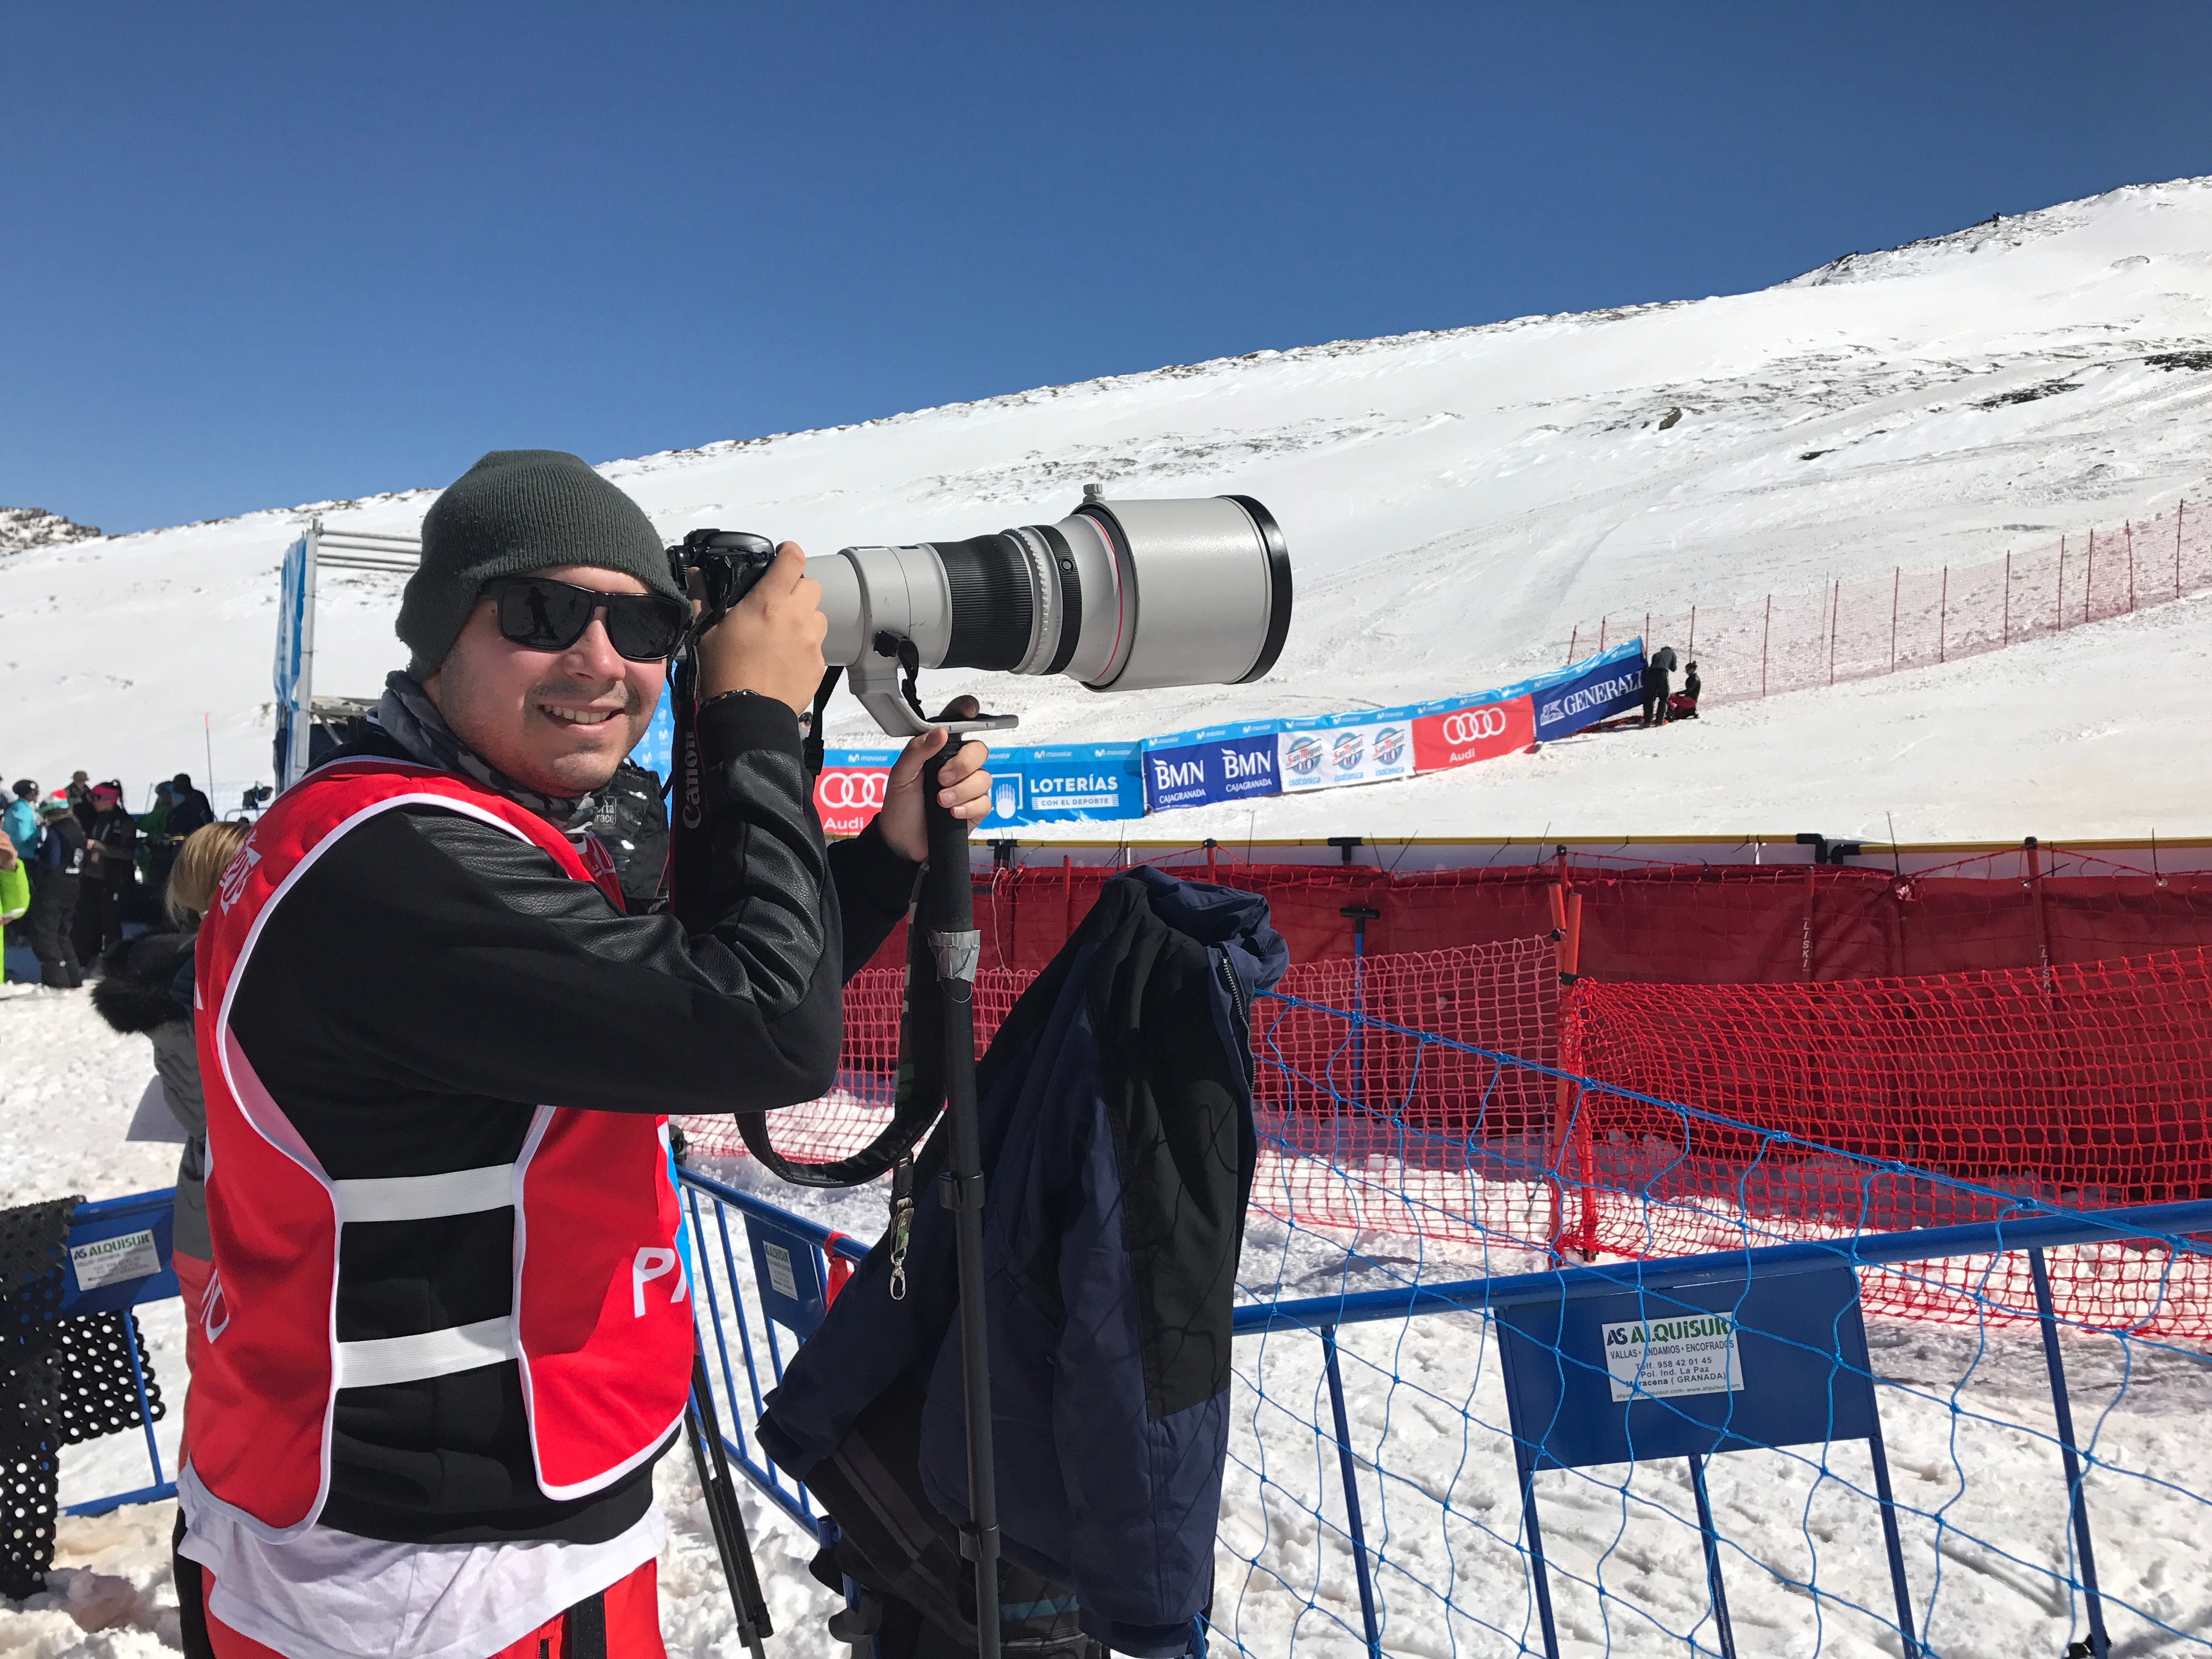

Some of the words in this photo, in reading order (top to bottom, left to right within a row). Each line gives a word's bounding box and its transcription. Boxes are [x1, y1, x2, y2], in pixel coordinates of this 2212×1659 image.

[1564, 670, 1644, 715] GENERALI
[1449, 748, 1475, 763] Audi
[1222, 750, 1271, 779] BMN
[683, 731, 702, 828] Canon
[1154, 760, 1204, 790] BMN
[1030, 774, 1118, 793] LOTERÍAS
[1226, 778, 1272, 793] CAJAGRANADA
[1159, 788, 1206, 804] CAJAGRANADA
[597, 799, 614, 814] rta
[594, 814, 614, 823] race
[823, 817, 864, 830] Audi
[1607, 1328, 1628, 1346] AS
[1610, 1349, 1638, 1359] VALLAS
[1646, 1345, 1680, 1356] NDAMIOS
[1626, 1379, 1668, 1388] Mracena
[1687, 1383, 1740, 1392] www.alquisur.om
